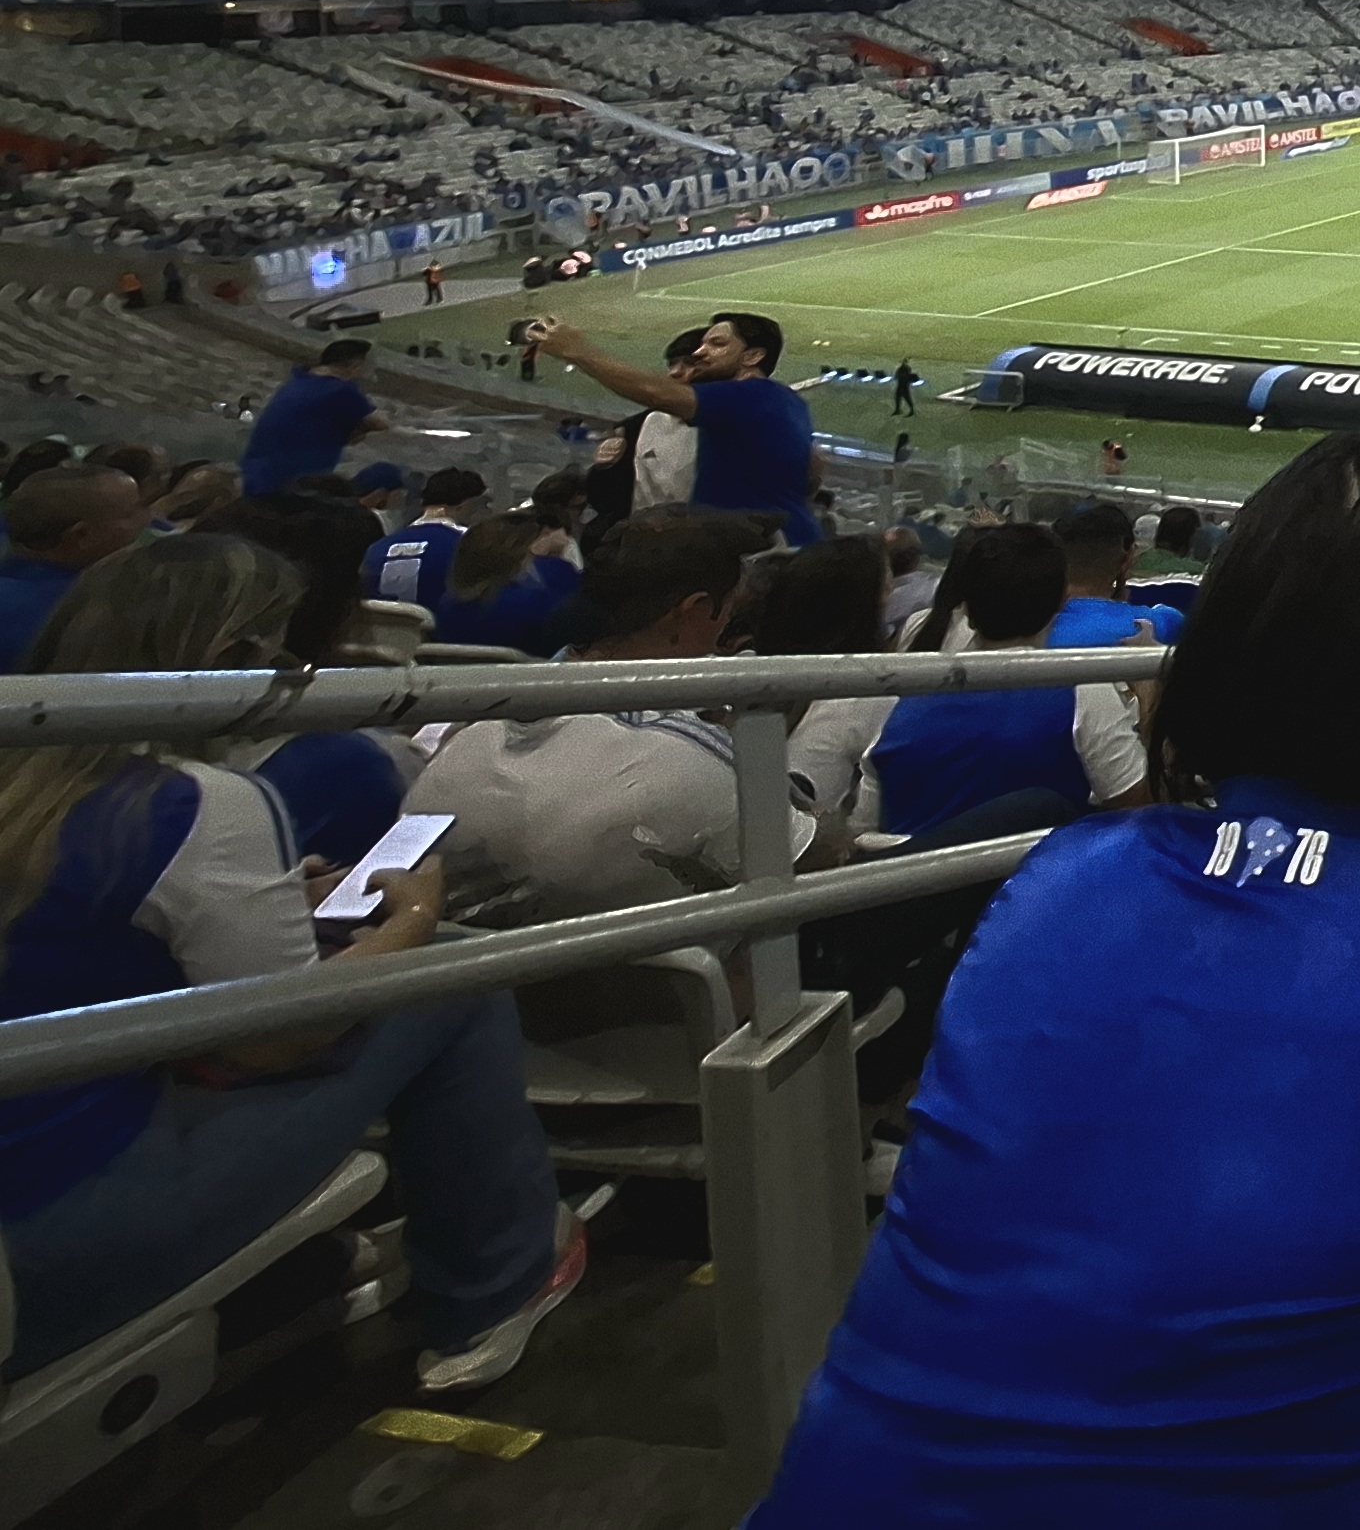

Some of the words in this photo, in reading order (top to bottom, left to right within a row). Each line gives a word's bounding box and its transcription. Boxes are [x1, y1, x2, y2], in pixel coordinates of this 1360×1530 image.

[1278, 128, 1320, 147] AMSTEL
[889, 195, 954, 215] mapfre
[622, 238, 714, 268] CONMEBOL
[783, 216, 837, 239] sempre
[1033, 351, 1223, 384] POWERADE
[1203, 822, 1242, 876] 19
[1283, 828, 1330, 885] 76
